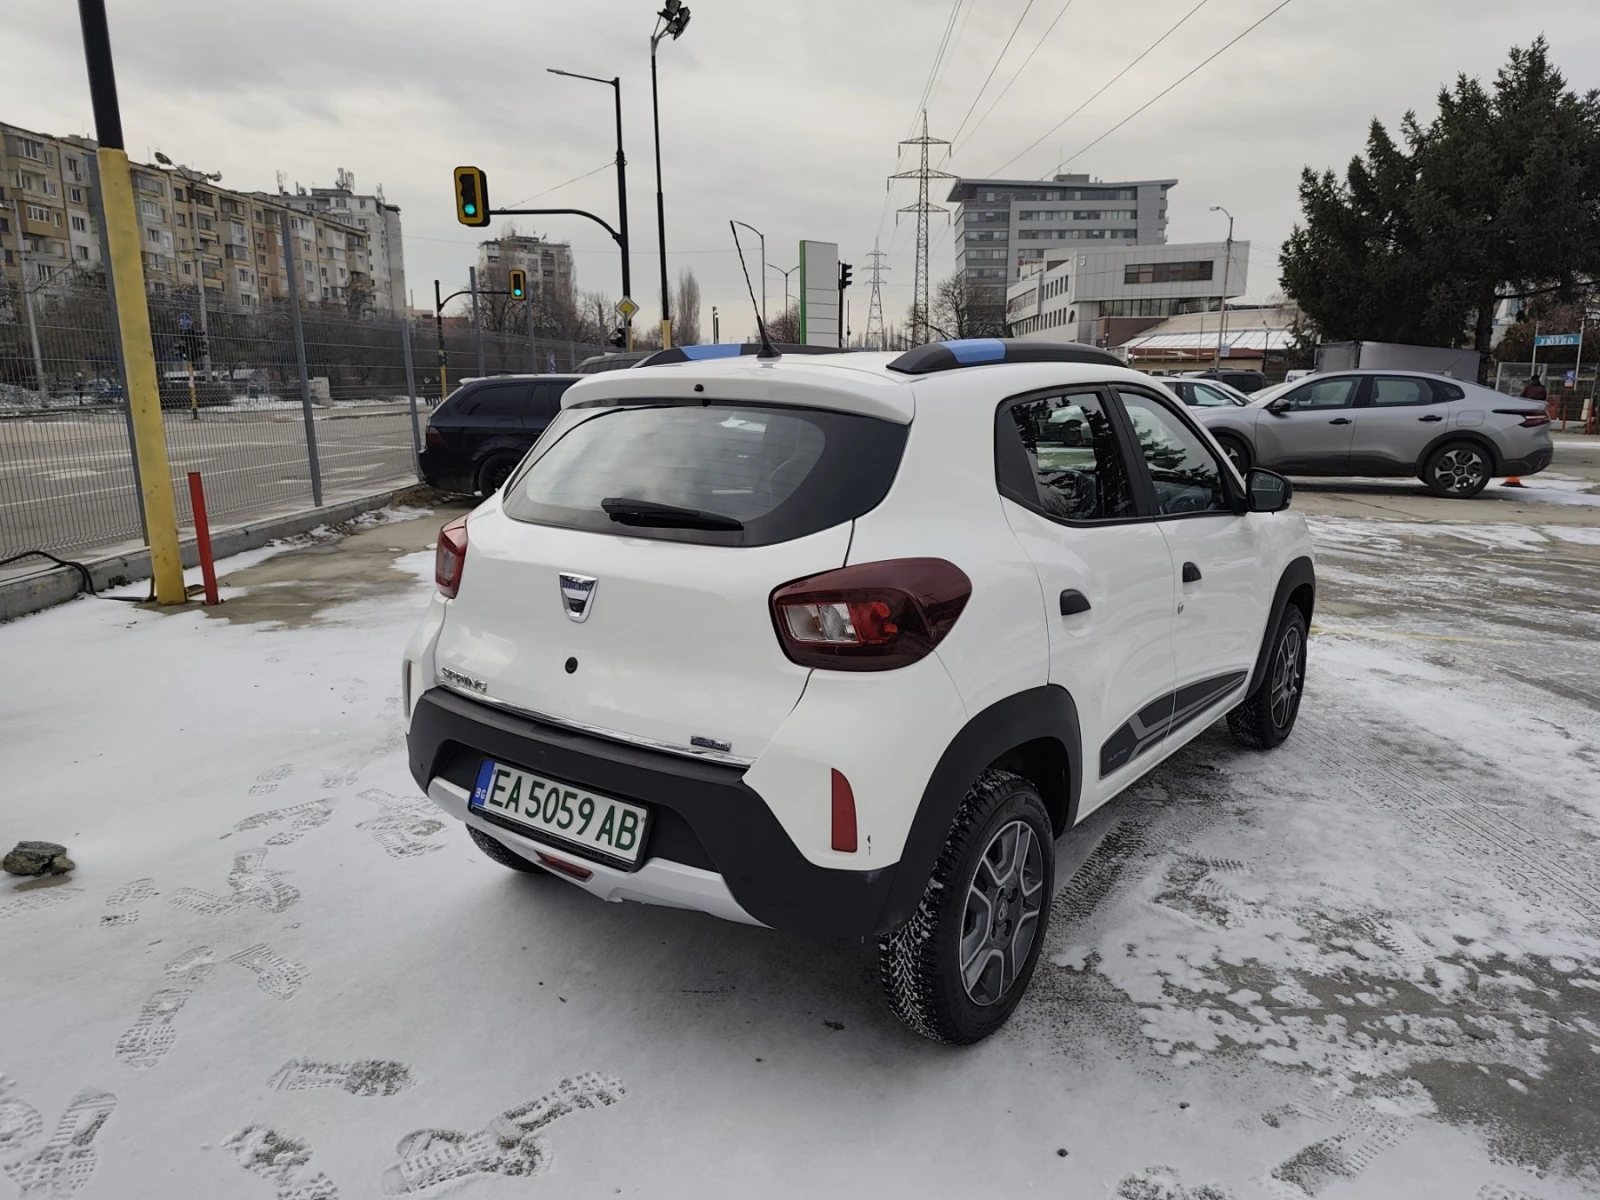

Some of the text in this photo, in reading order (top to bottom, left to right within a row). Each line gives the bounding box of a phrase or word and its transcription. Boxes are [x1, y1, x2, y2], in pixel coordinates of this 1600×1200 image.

[1080, 255, 1087, 267] 3
[442, 667, 487, 692] SPRING
[475, 787, 487, 799] BG
